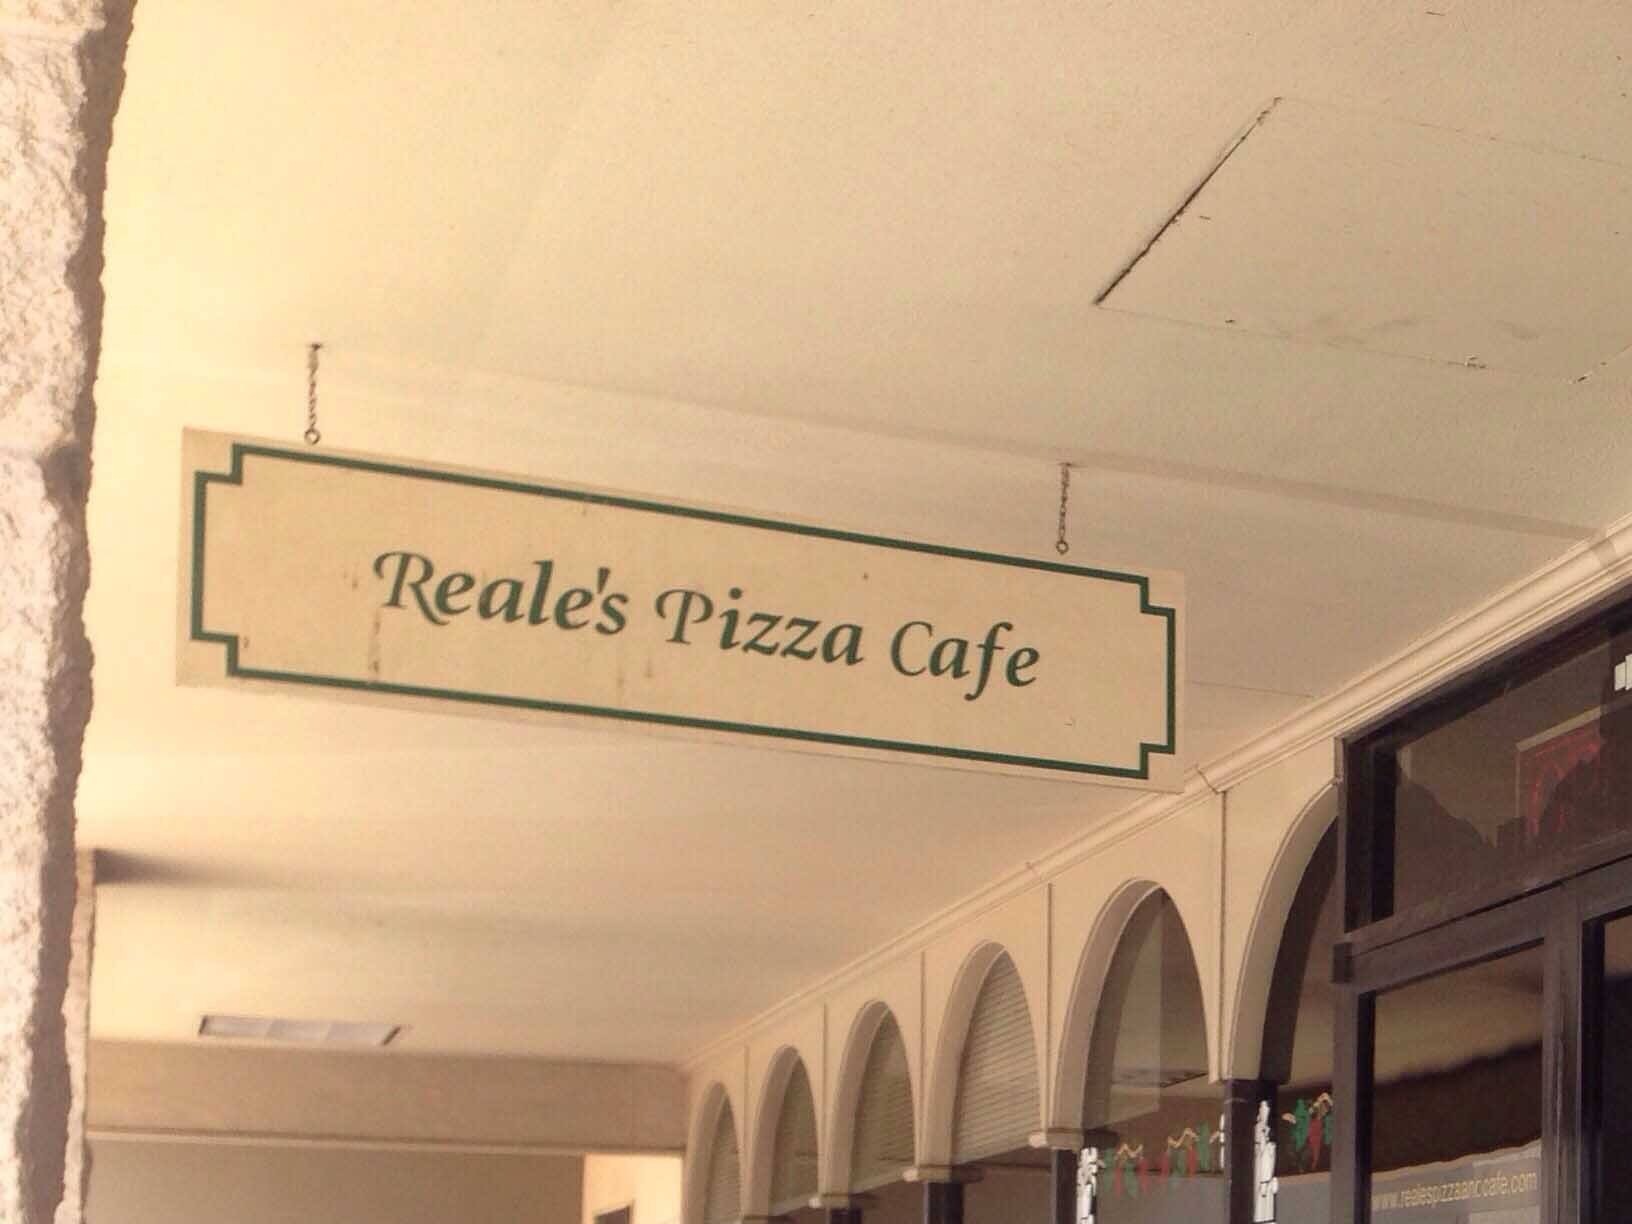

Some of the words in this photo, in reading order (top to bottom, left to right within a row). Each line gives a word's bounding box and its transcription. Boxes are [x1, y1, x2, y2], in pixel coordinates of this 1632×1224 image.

[373, 550, 630, 637] Reale's
[655, 586, 865, 667] Pizza
[889, 620, 1041, 702] Cafe
